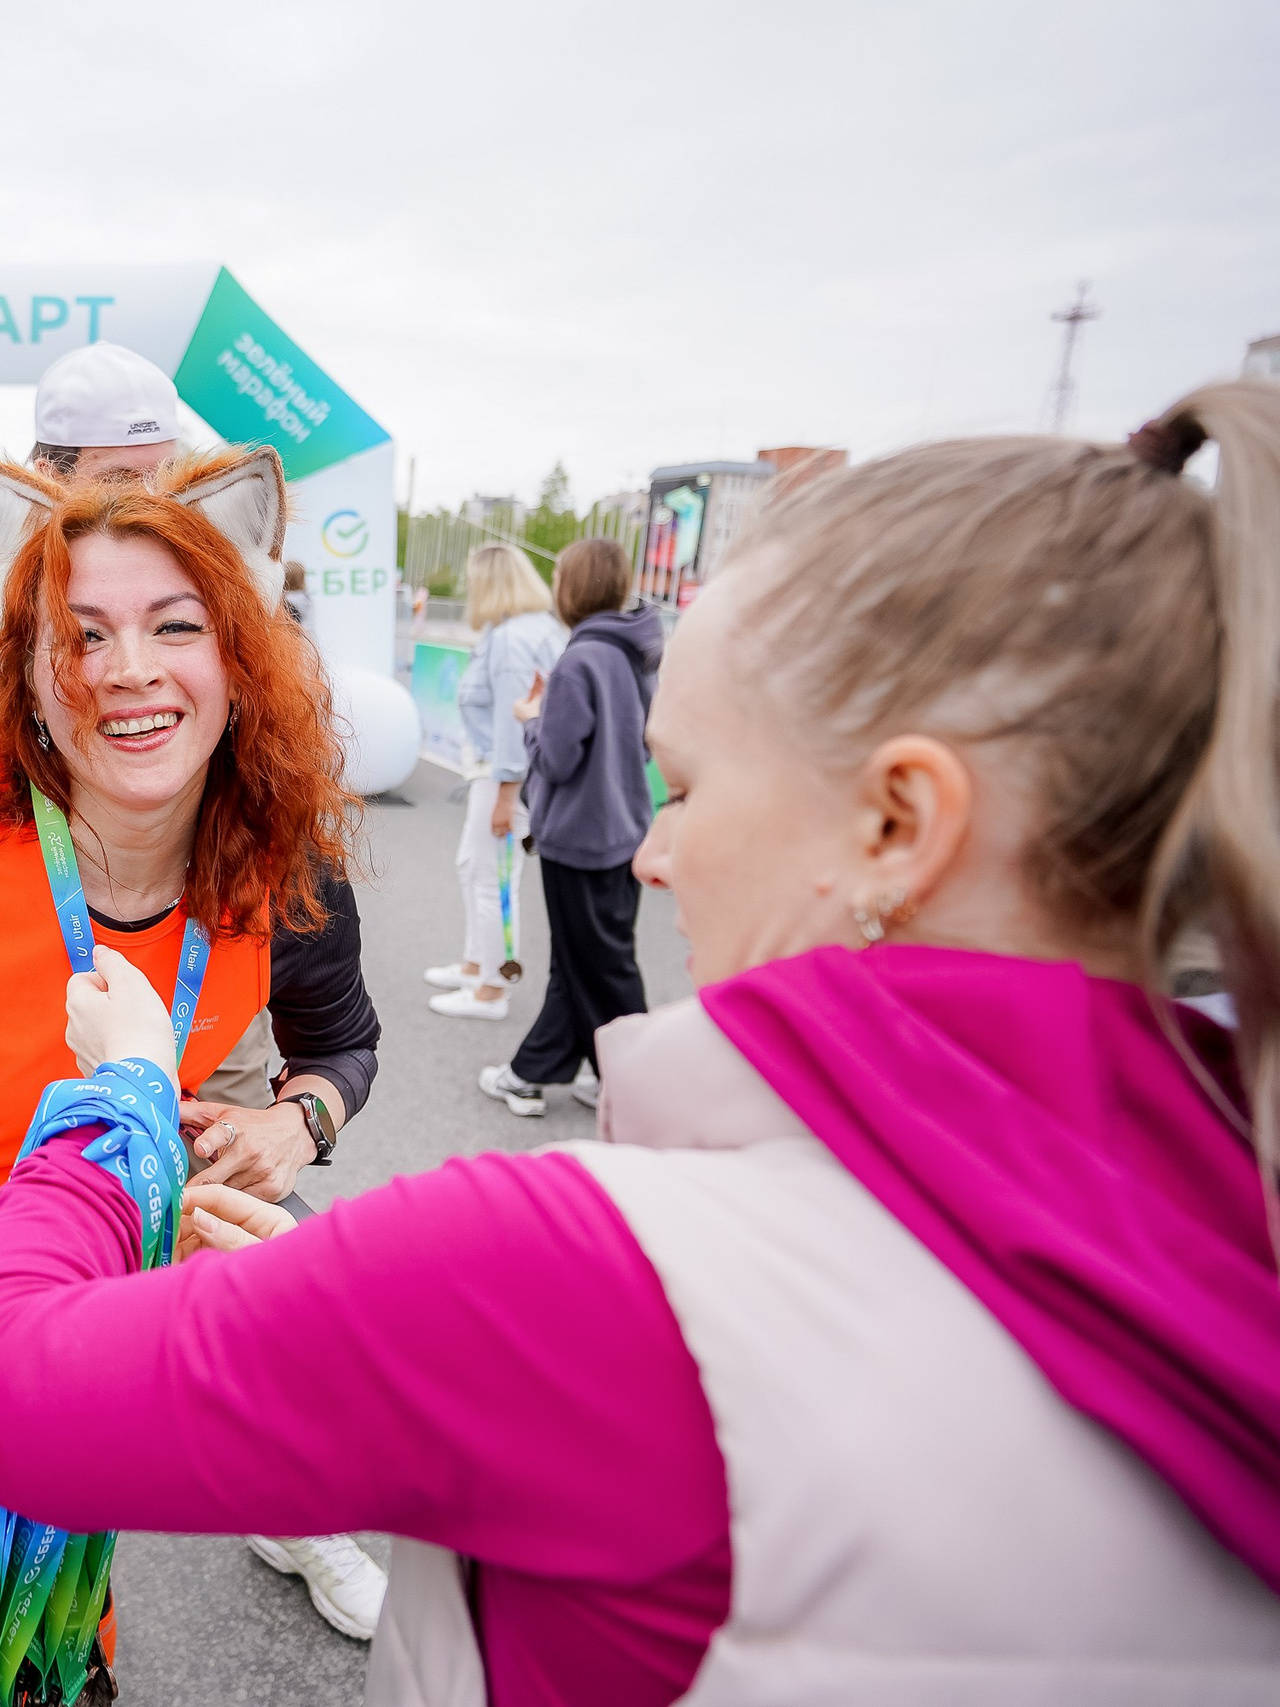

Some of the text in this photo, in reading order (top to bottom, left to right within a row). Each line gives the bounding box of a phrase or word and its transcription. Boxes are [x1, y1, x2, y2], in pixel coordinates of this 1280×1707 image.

[218, 350, 311, 444] марафон
[70, 914, 84, 940] Utair
[187, 945, 200, 972] Utair
[168, 1139, 184, 1187] СБЕР
[148, 1182, 162, 1234] СБЕР
[34, 1524, 56, 1565] СБЕР
